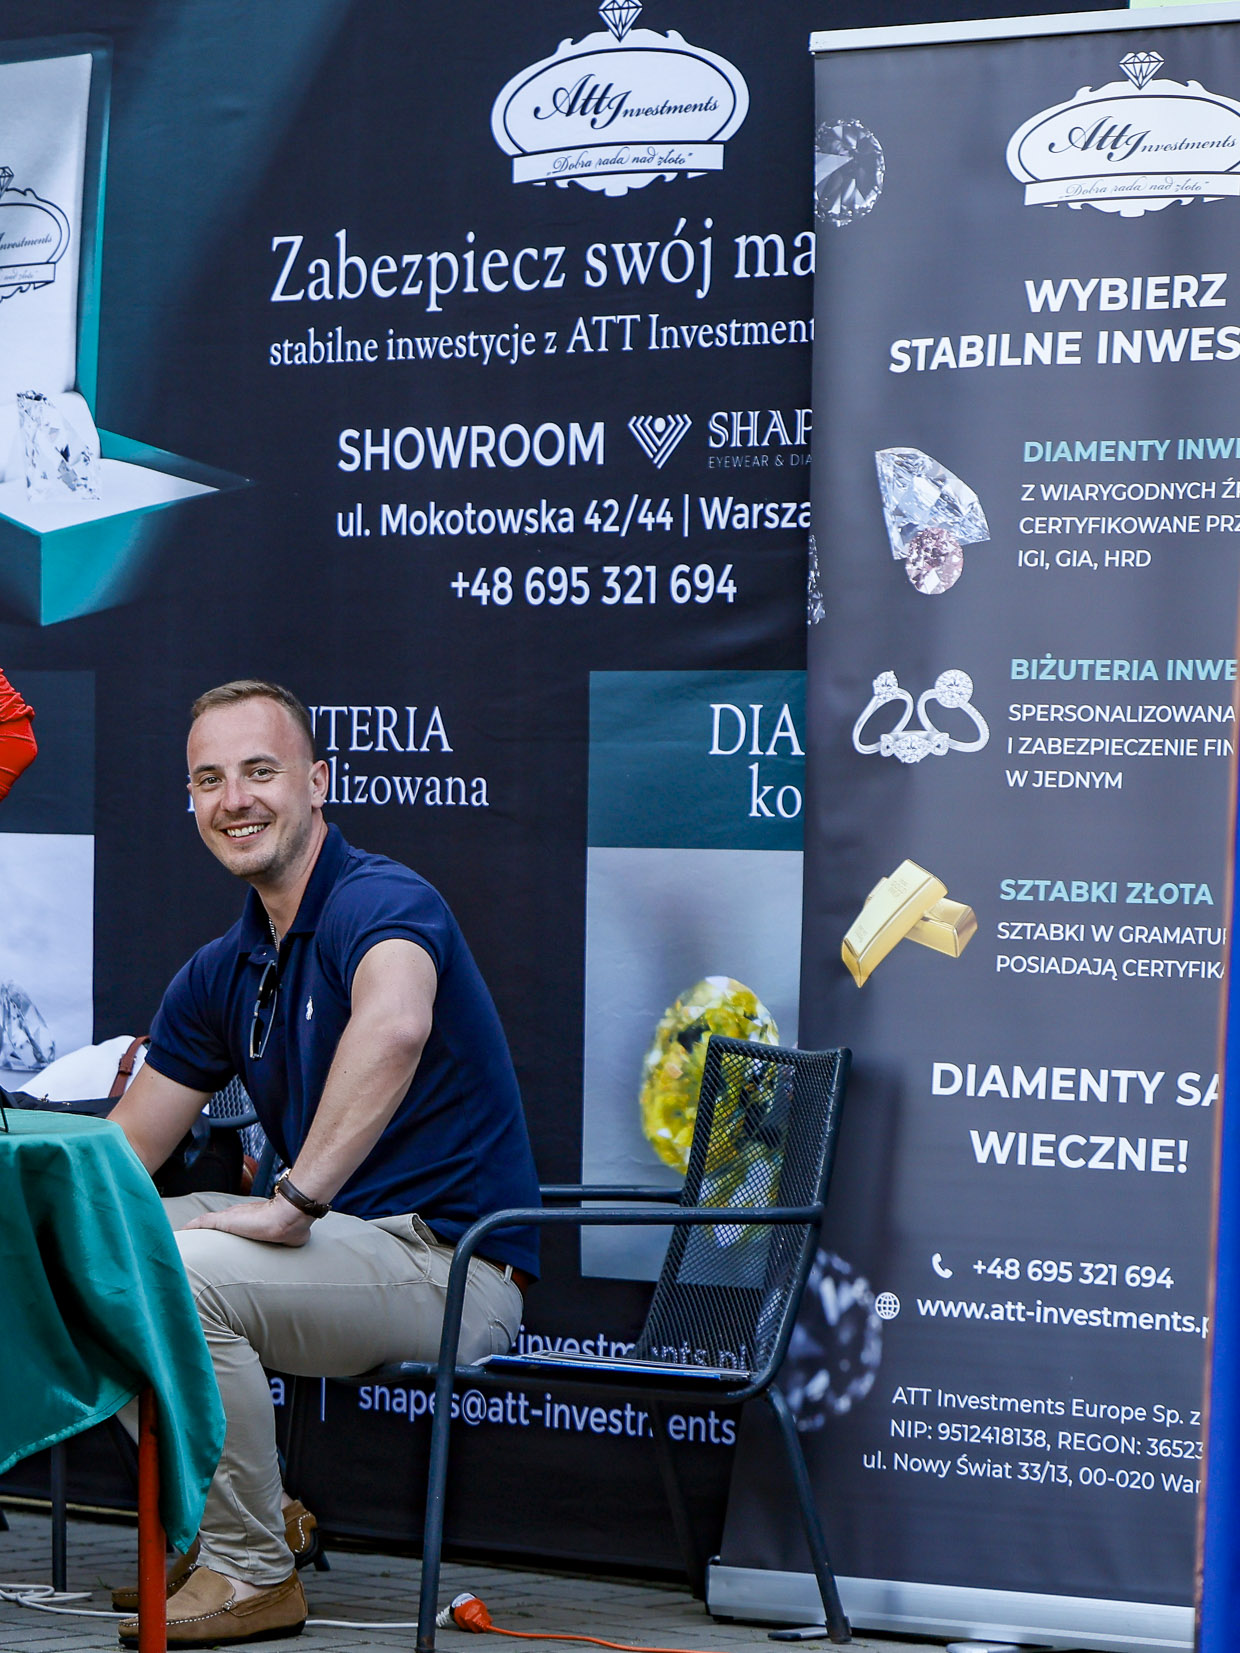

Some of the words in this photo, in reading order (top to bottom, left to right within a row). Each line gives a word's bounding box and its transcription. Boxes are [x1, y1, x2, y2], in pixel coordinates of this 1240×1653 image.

[595, 146, 630, 168] rada
[631, 146, 657, 164] nad
[1109, 176, 1147, 193] rada
[1149, 176, 1173, 191] nad
[269, 228, 566, 312] Zabezpiecz
[583, 217, 714, 300] swój
[733, 232, 815, 280] ma
[1023, 273, 1228, 313] WYBIERZ
[269, 324, 379, 366] stabilne
[385, 323, 536, 366] inwestycje
[543, 330, 558, 355] z
[565, 315, 642, 354] ATT
[888, 331, 1083, 374] STABILNE
[1097, 325, 1240, 365] INWES
[337, 421, 606, 473] SHOWROOM
[708, 409, 812, 448] SHAP
[708, 455, 769, 469] EYEWEAR
[775, 454, 785, 467] &
[790, 453, 813, 466] DIA
[1023, 439, 1171, 463] DIAMENTY
[1020, 484, 1036, 501] Z
[1040, 481, 1216, 501] WIARYGODNYCH
[336, 503, 372, 538] ul.
[380, 498, 576, 537] Mokotowska
[582, 496, 674, 538] 42/44
[1019, 515, 1200, 535] CERTYFIKOWANE
[1017, 549, 1050, 570] IGI,
[1055, 550, 1099, 570] GIA,
[1104, 550, 1152, 567] HRD
[449, 566, 513, 606] +48
[524, 565, 591, 605] 695
[601, 564, 658, 605] 321
[668, 563, 738, 604] 694
[1010, 652, 1159, 681] BIŻUTERIA
[1166, 659, 1238, 681] INWE
[708, 703, 806, 756] DIA
[1008, 703, 1236, 723] SPERSONALIZOWANA
[1008, 737, 1013, 754] I
[1018, 737, 1198, 756] ZABEZPIECZENIE
[324, 756, 490, 807] lizowana
[748, 762, 803, 819] ko
[1005, 770, 1028, 787] W
[1032, 770, 1123, 789] JEDNYM
[999, 879, 1117, 904] SZTABKI
[1125, 882, 1214, 906] ZŁOTA
[996, 922, 1085, 942] SZTABKI
[1091, 924, 1114, 943] W
[996, 955, 1118, 981] POSIADAJĄ
[931, 1062, 1166, 1105] DIAMENTY
[969, 1129, 1189, 1174] WIECZNE!
[973, 1257, 1021, 1281] +48
[1026, 1259, 1073, 1284] 695
[1078, 1262, 1118, 1287] 321
[1124, 1265, 1175, 1289] 694
[891, 1386, 932, 1406] ATT
[937, 1389, 1065, 1416] Investments
[1071, 1398, 1147, 1424] Europe
[1152, 1404, 1185, 1428] Sp.
[1189, 1411, 1201, 1427] z
[890, 1418, 933, 1440] NIP:
[937, 1423, 1051, 1451] 9512418138,
[1057, 1431, 1142, 1455] REGON:
[862, 1450, 887, 1470] ul.
[893, 1453, 951, 1478] Nowy
[956, 1453, 1012, 1479] Świat
[1017, 1461, 1073, 1487] 33/13,
[1078, 1466, 1154, 1490] 00-020
